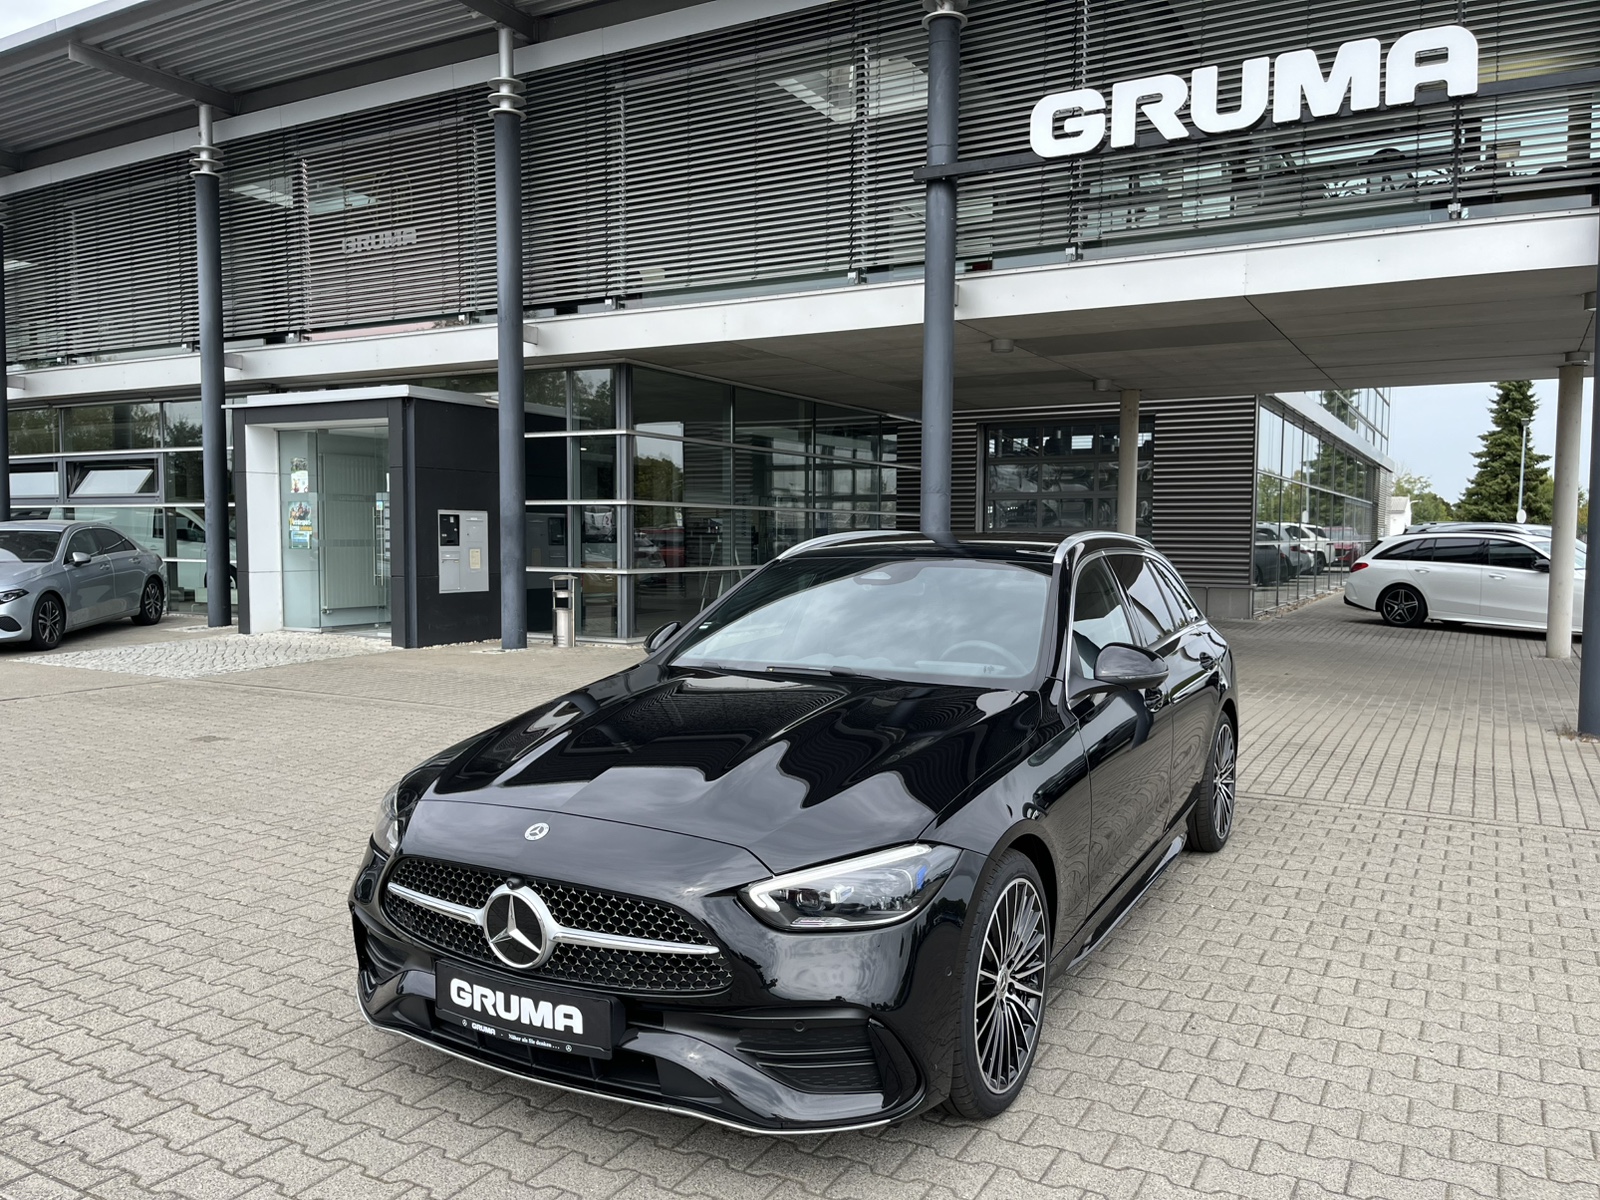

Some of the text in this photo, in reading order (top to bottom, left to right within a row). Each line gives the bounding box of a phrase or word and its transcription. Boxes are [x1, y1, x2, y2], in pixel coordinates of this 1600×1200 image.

[1029, 25, 1480, 159] GRUMA
[341, 227, 418, 253] GRUMA
[450, 977, 584, 1035] GRUMA
[471, 1022, 496, 1036] GRUMA
[535, 1040, 552, 1048] denken
